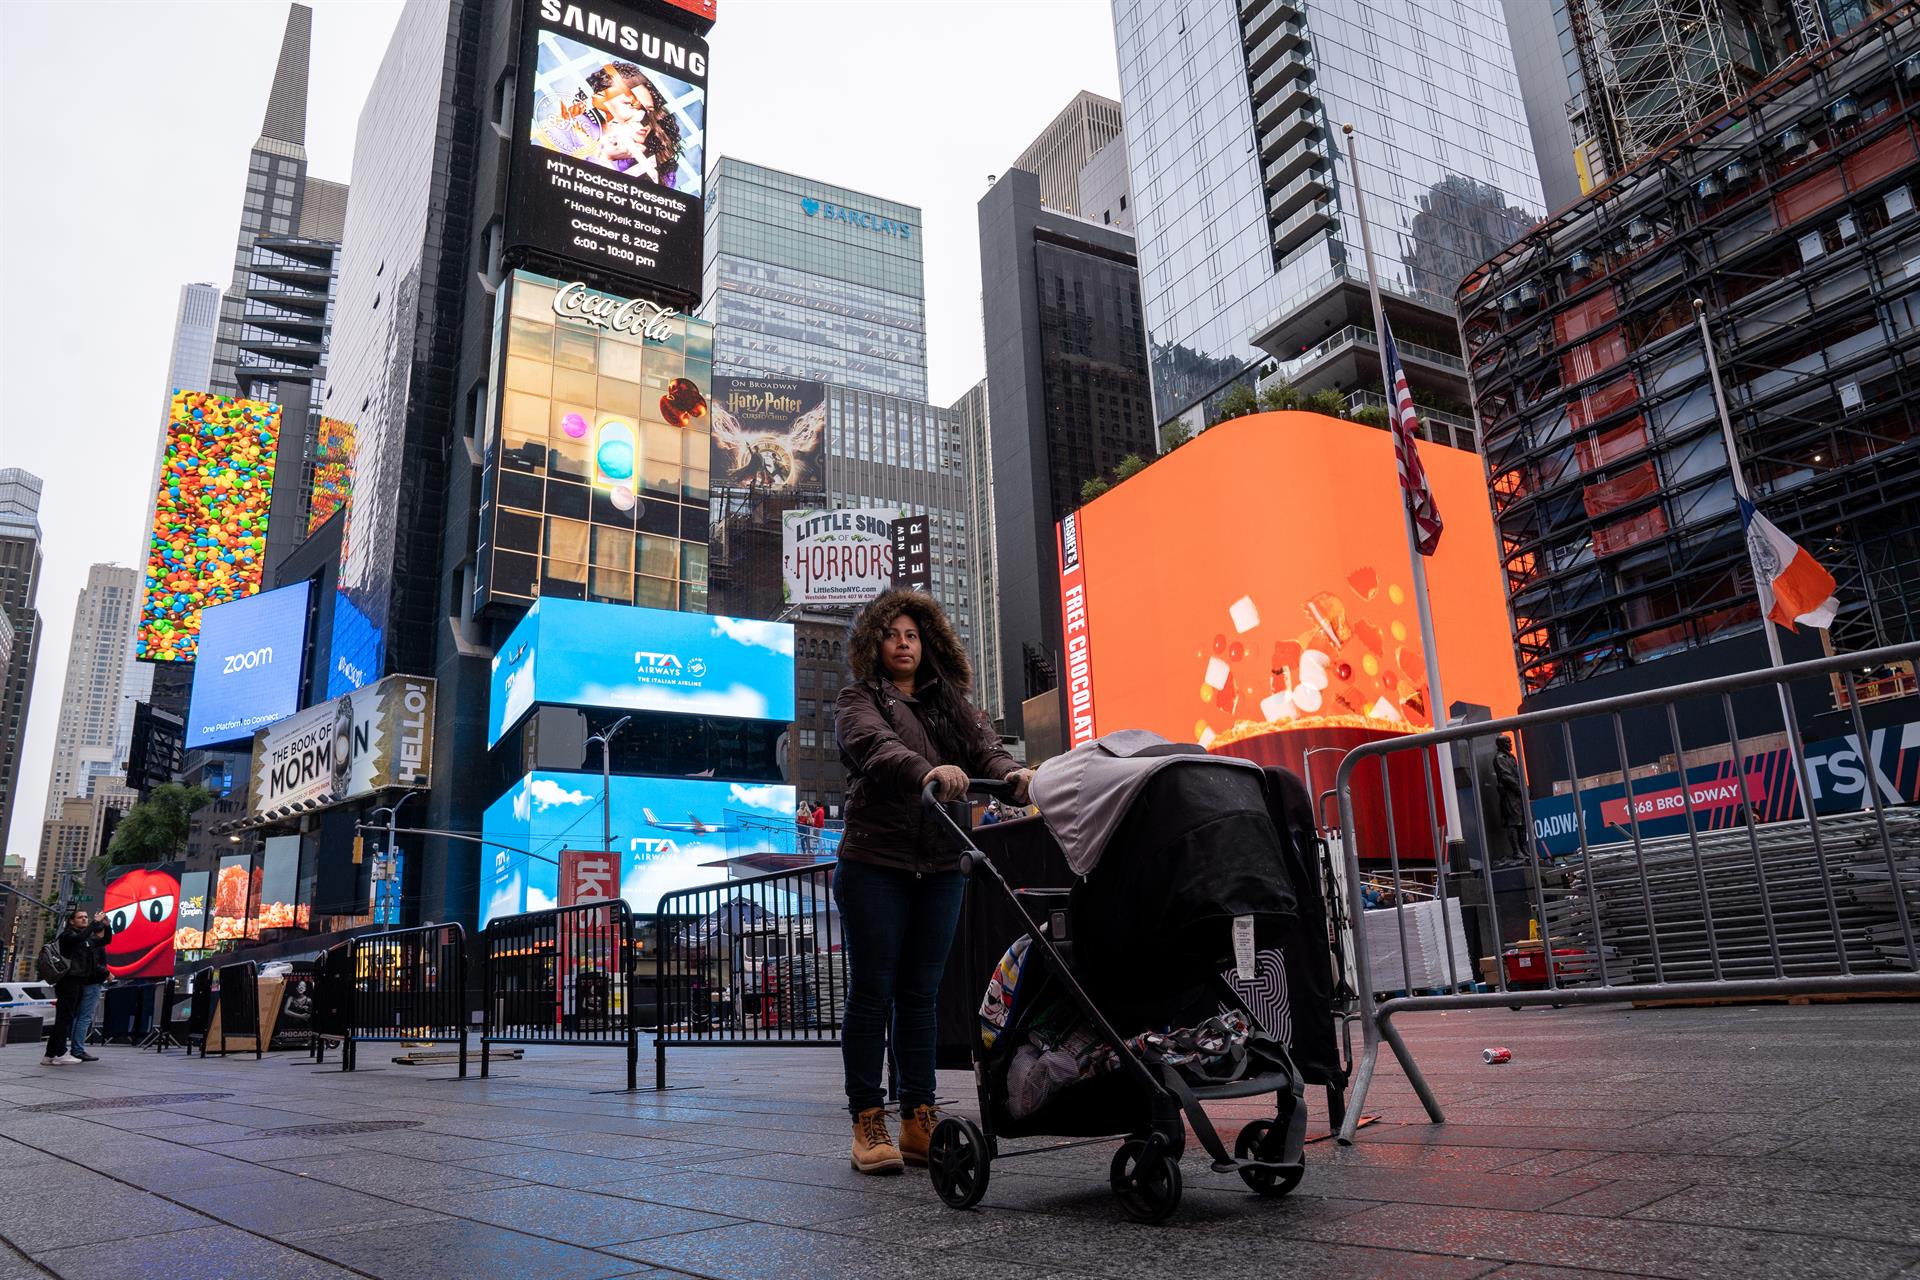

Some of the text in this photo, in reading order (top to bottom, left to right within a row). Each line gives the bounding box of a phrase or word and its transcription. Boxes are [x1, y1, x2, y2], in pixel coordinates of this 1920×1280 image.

[540, 0, 706, 77] SAMSUNG
[546, 159, 687, 213] MTY Podcast Presents:
[551, 174, 572, 190] I'm
[573, 181, 605, 200] Here
[606, 192, 628, 207] For
[629, 198, 652, 215] You
[654, 206, 681, 223] Tour
[571, 218, 660, 253] October 8, 2022
[823, 203, 911, 239] BARCLAYS
[573, 236, 598, 251] 6:00
[607, 245, 634, 262] 10:00
[635, 254, 656, 268] pm
[726, 391, 803, 417] Harry Potter
[796, 513, 852, 542] LITTLE
[796, 544, 893, 590] HORRORS
[897, 526, 907, 577] THE NEW
[813, 586, 877, 595] LittleShopNYC.com
[1065, 583, 1086, 634] FREE
[223, 646, 273, 675] zoom
[634, 651, 683, 668] ITA
[637, 666, 681, 676] AIRWAYS
[651, 677, 677, 685] ITALIAN
[202, 725, 215, 734] One
[243, 718, 250, 726] to
[251, 712, 279, 725] Connect
[398, 683, 427, 782] HELLO!
[272, 745, 289, 765] THE
[290, 730, 317, 756] BOOK
[318, 722, 332, 741] OF
[1803, 728, 1905, 810] TSX
[630, 838, 680, 853] ITA
[280, 1030, 314, 1038] CHICAGO
